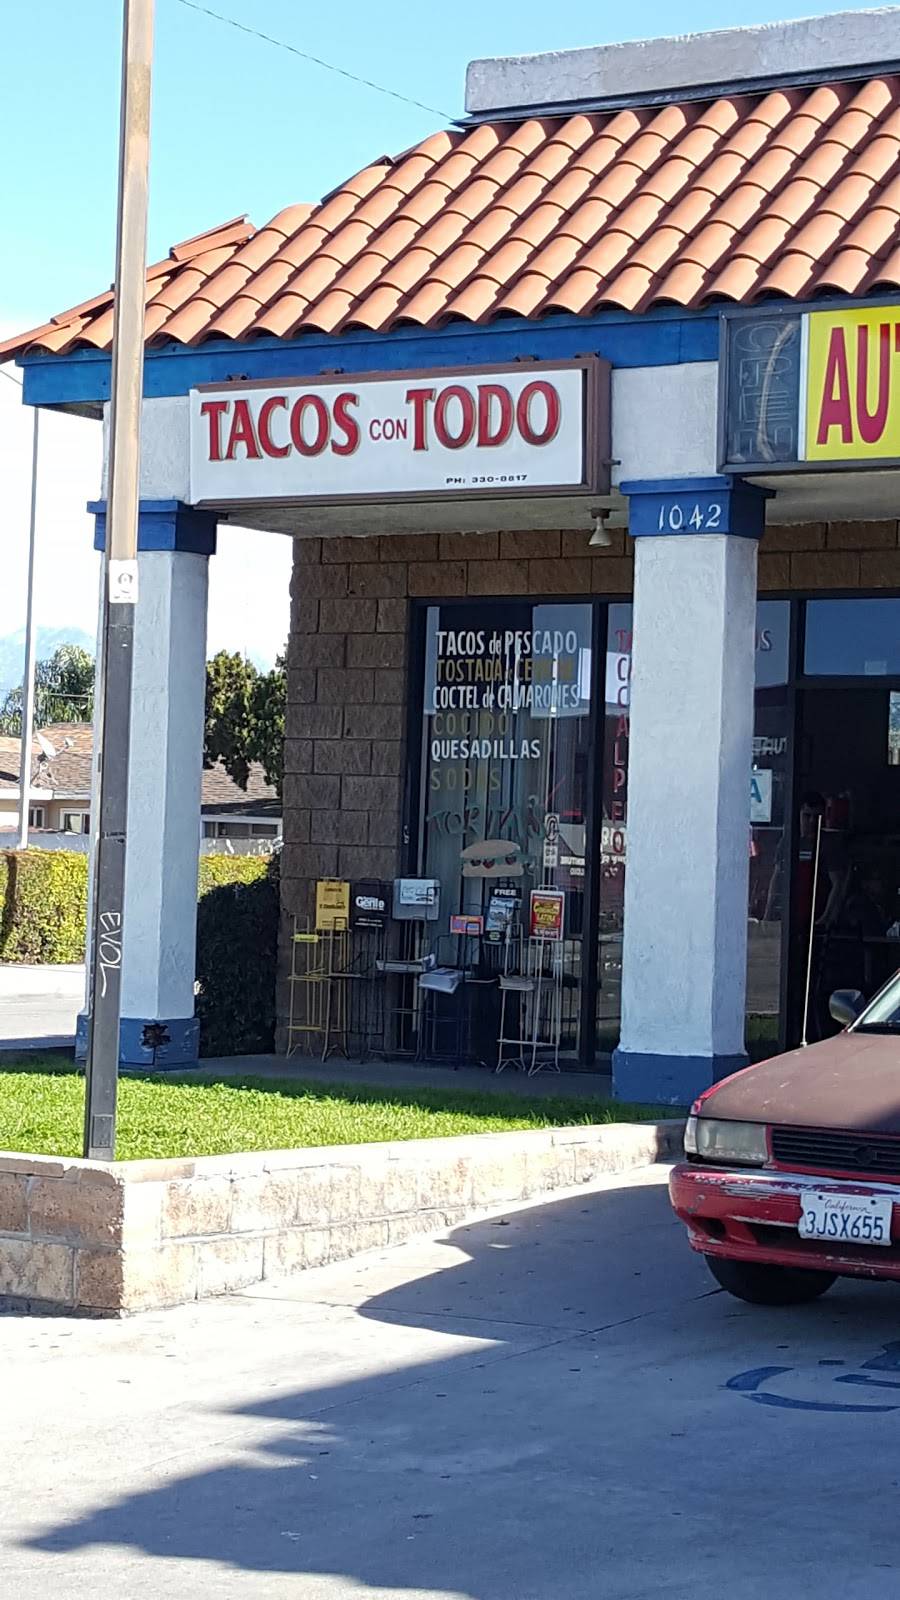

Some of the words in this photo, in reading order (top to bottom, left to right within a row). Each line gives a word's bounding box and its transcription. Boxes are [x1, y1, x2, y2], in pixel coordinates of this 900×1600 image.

[200, 392, 361, 461] TACOS
[369, 418, 407, 441] CON
[405, 380, 560, 451] TODO
[659, 504, 721, 530] 1042
[436, 631, 485, 656] TACOS
[504, 630, 577, 655] PESCADO
[437, 658, 503, 682] TOSTADA
[433, 685, 479, 709] COCTEL
[497, 684, 580, 710] CAMARONES
[431, 740, 541, 762] QUESADILLAS
[494, 888, 517, 897] FREE
[824, 1198, 872, 1214] California
[805, 1210, 884, 1240] 3JSX655
